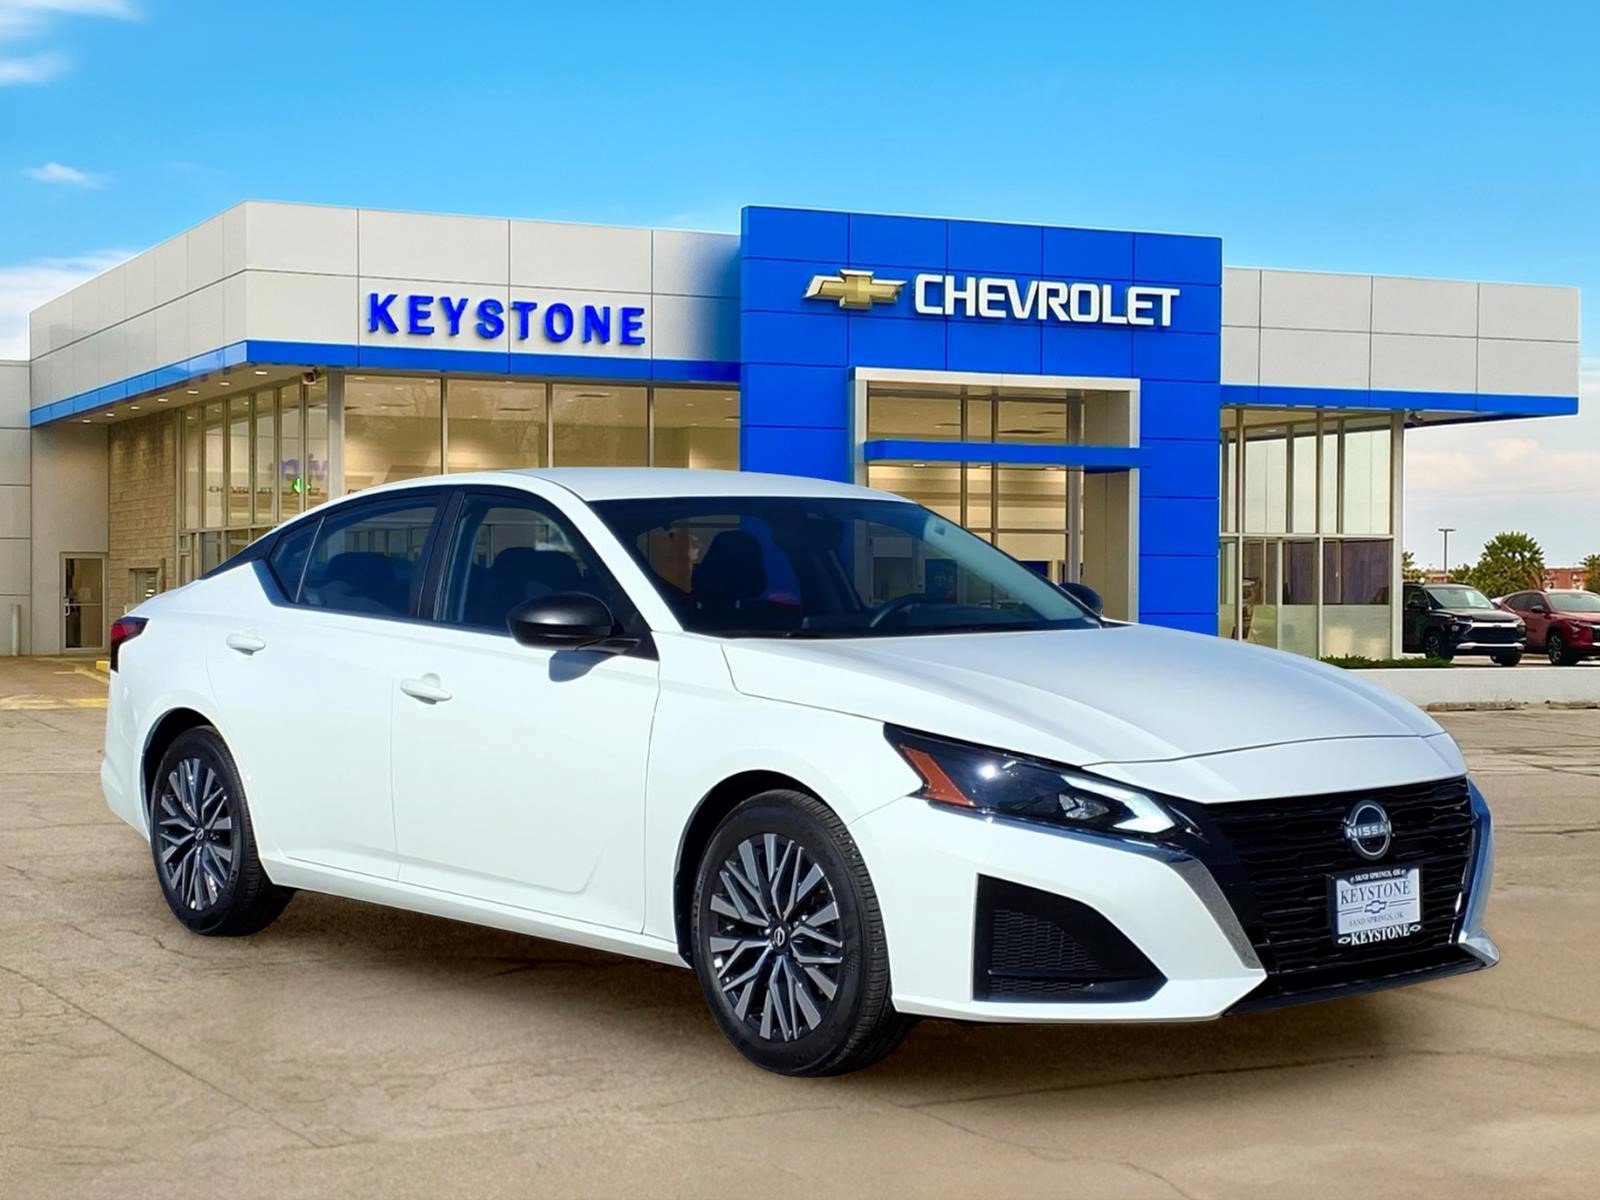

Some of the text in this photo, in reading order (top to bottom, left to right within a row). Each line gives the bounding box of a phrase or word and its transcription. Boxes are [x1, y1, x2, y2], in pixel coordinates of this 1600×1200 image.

[368, 292, 645, 346] KEYSTONE
[914, 273, 1181, 327] CHEVROLET
[1340, 880, 1411, 905] KEYSTONE
[1351, 924, 1411, 946] KEYSTONE
